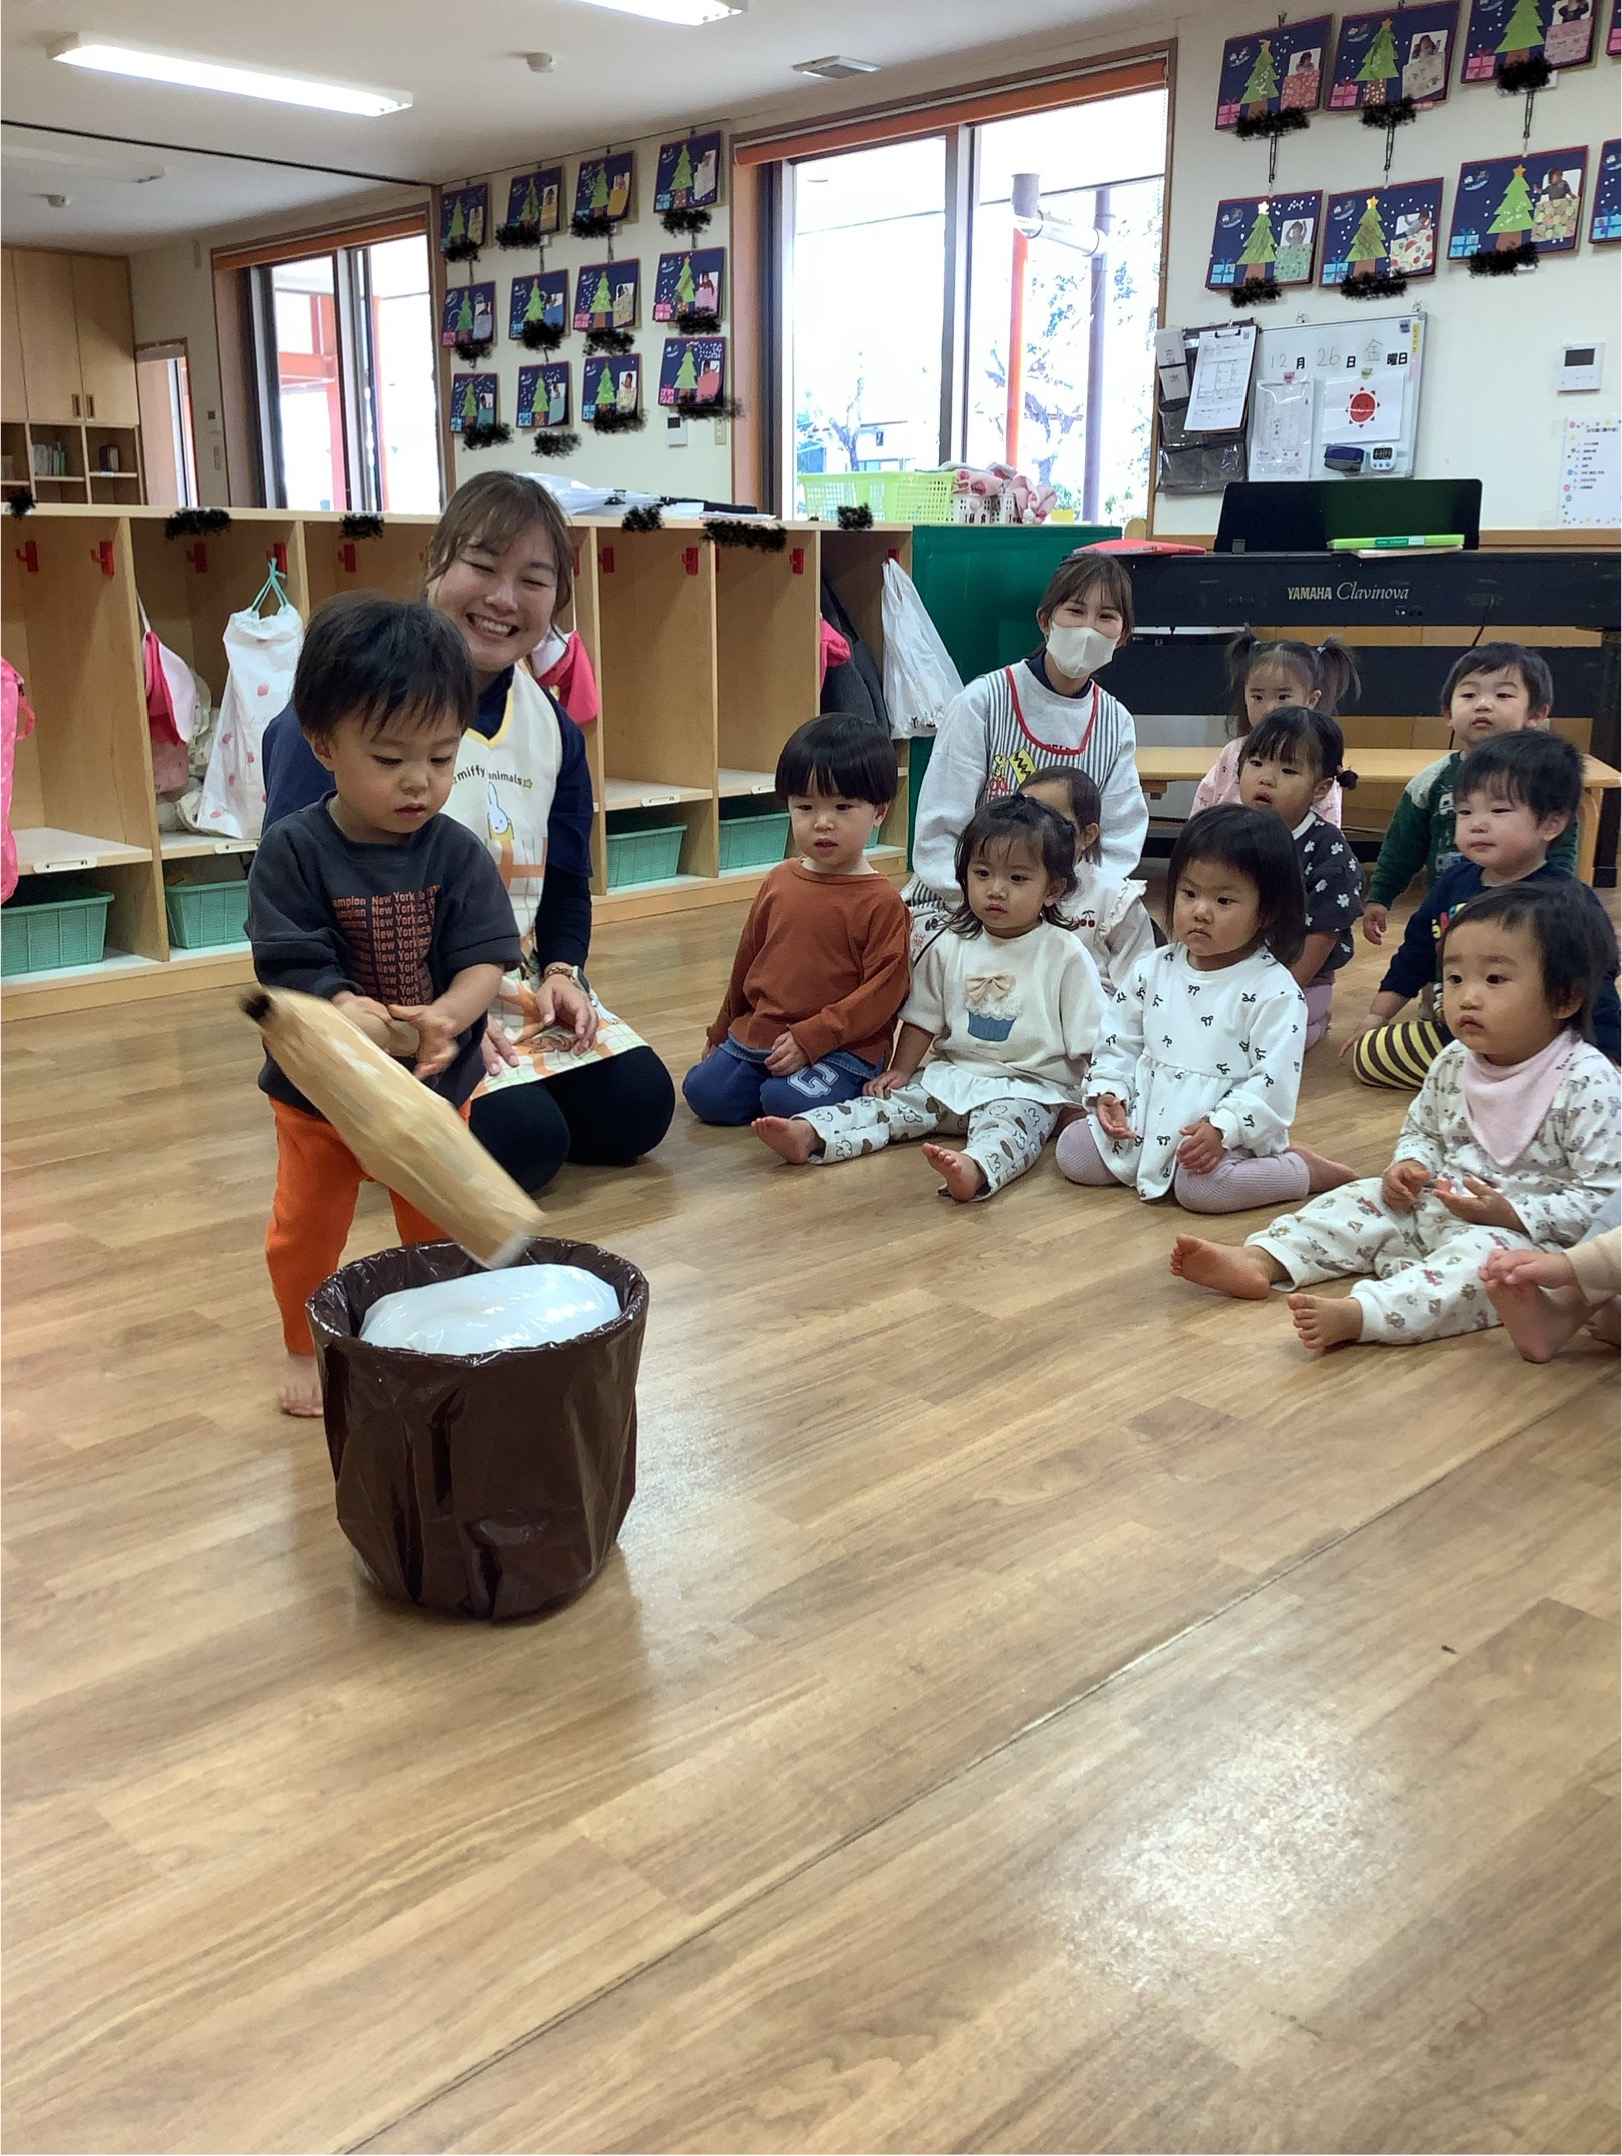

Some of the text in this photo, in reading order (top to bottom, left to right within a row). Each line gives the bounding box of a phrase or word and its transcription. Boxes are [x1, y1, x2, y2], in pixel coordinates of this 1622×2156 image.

[1270, 338, 1408, 370] 12 月 26 日 金 曜日
[1287, 581, 1410, 601] YAMAHA Clavinova
[457, 764, 486, 781] miffy
[372, 895, 392, 906] New
[393, 890, 416, 903] York
[371, 905, 393, 916] New
[394, 902, 416, 914] York
[372, 916, 394, 928] New
[395, 913, 417, 926] York
[373, 928, 395, 940] New
[374, 940, 395, 951] New
